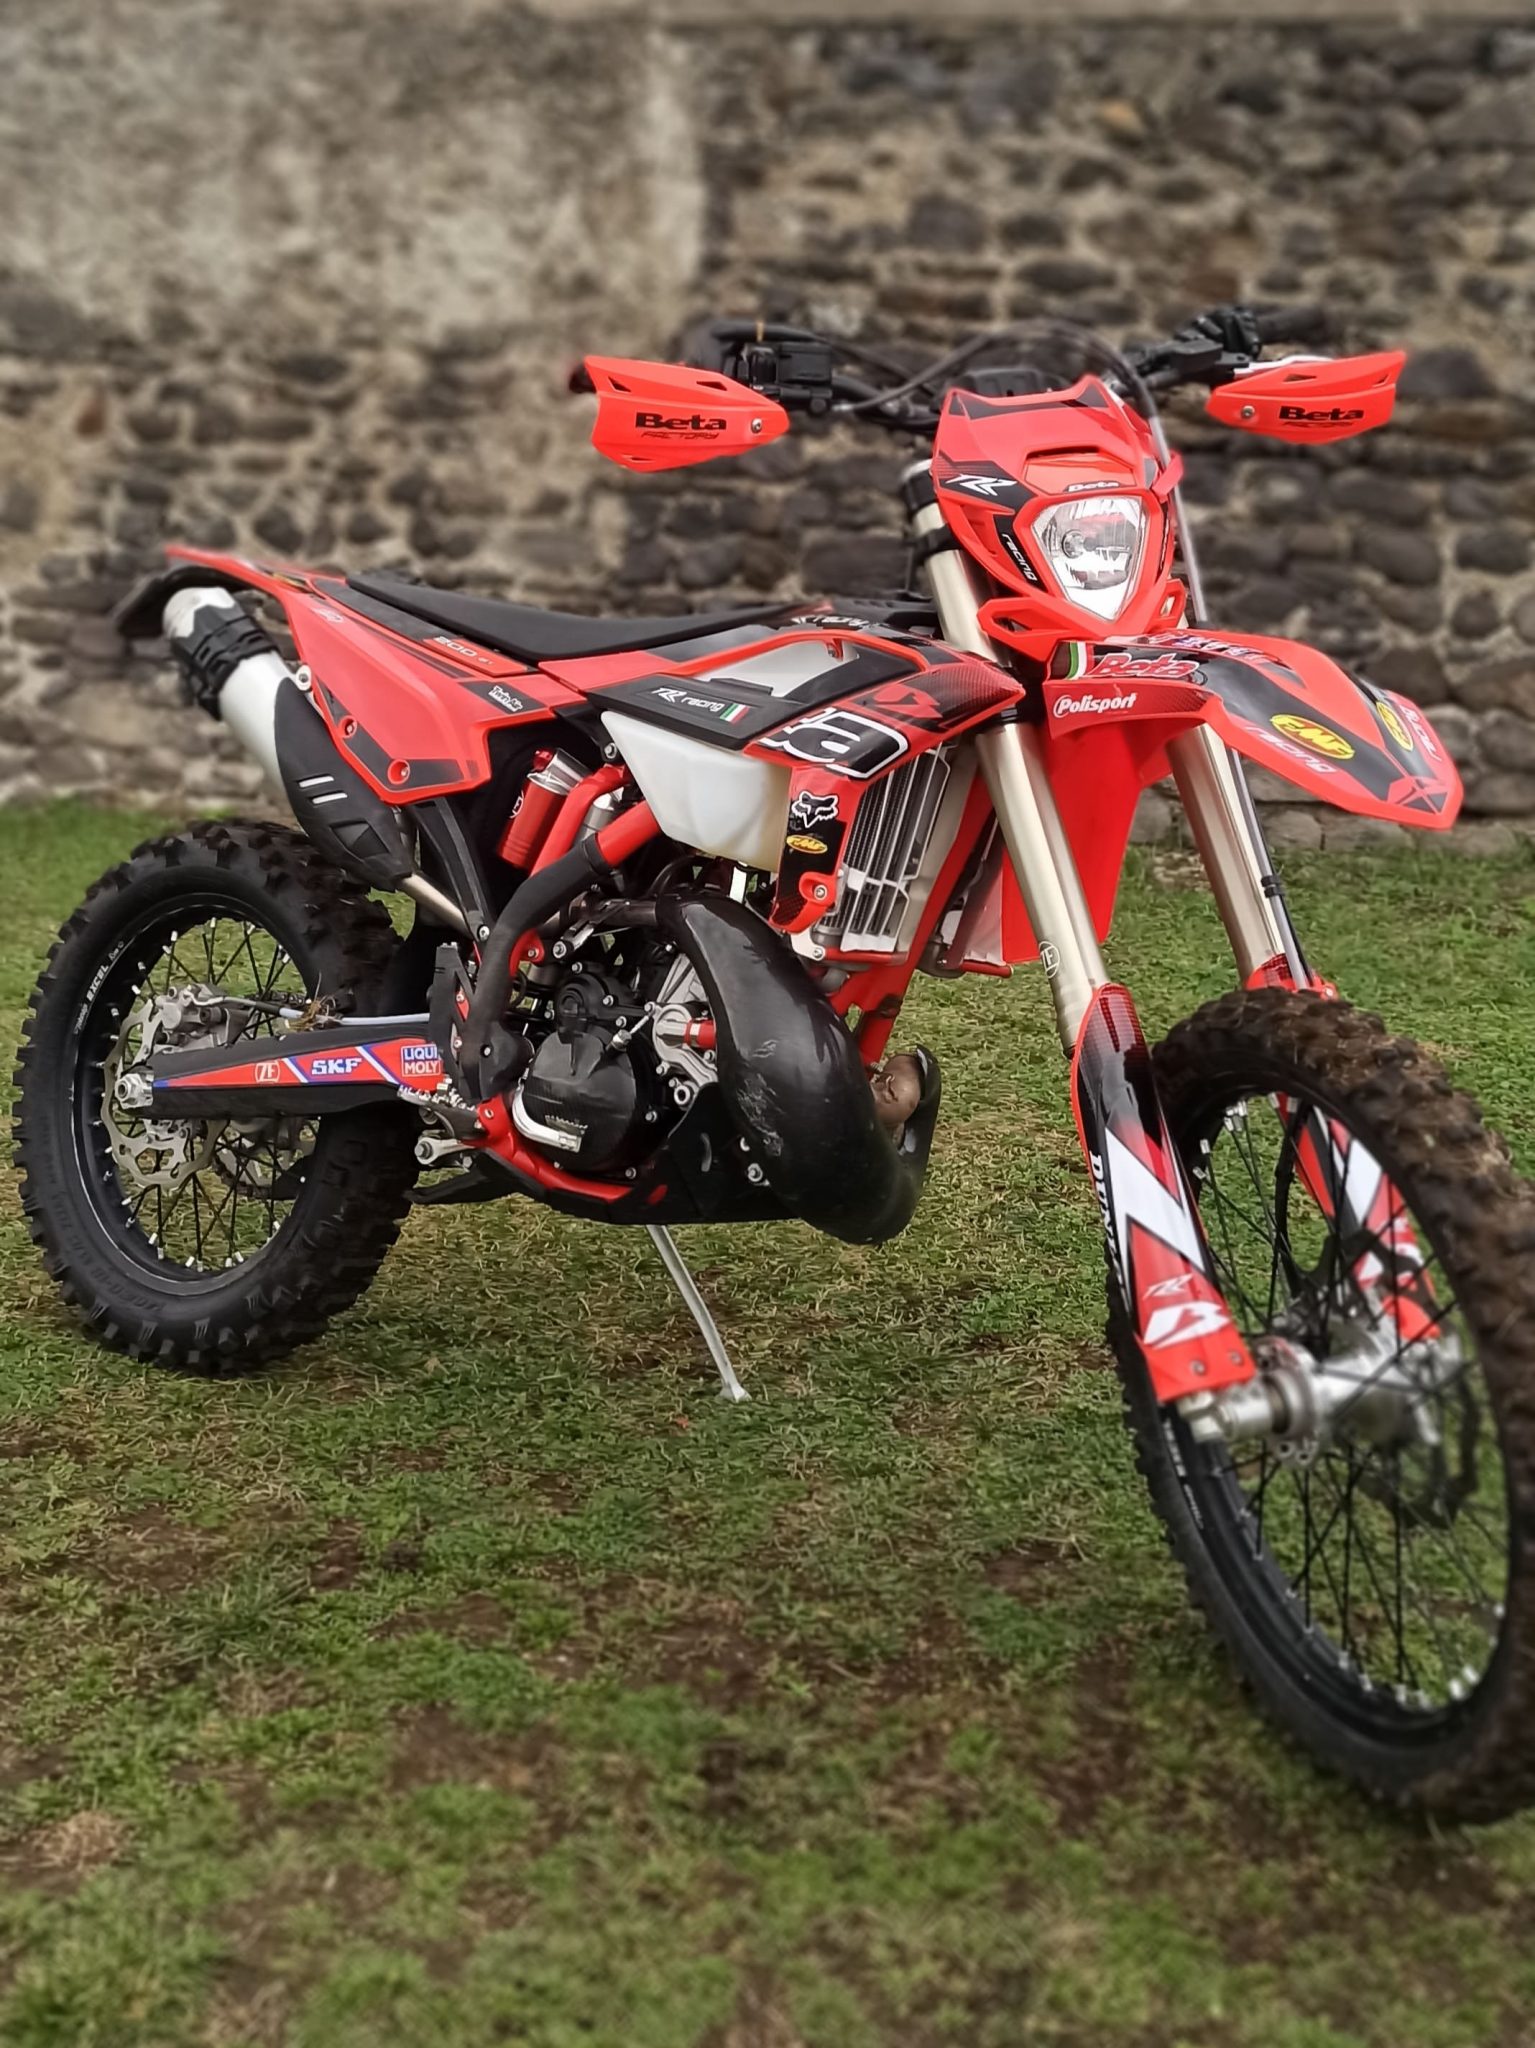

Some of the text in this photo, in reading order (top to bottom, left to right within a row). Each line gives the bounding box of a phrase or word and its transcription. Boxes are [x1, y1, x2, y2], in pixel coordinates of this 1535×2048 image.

[635, 412, 727, 431] Beta
[1279, 405, 1365, 421] Beta
[1068, 481, 1120, 493] Beta
[1001, 533, 1038, 582] racing
[1083, 652, 1200, 679] Beta
[680, 697, 725, 712] racing
[1053, 692, 1138, 718] Polisport
[1270, 715, 1355, 759] FMF
[404, 1047, 438, 1061] LIQUI
[312, 1058, 362, 1075] SKF
[404, 1062, 440, 1074] MOLY
